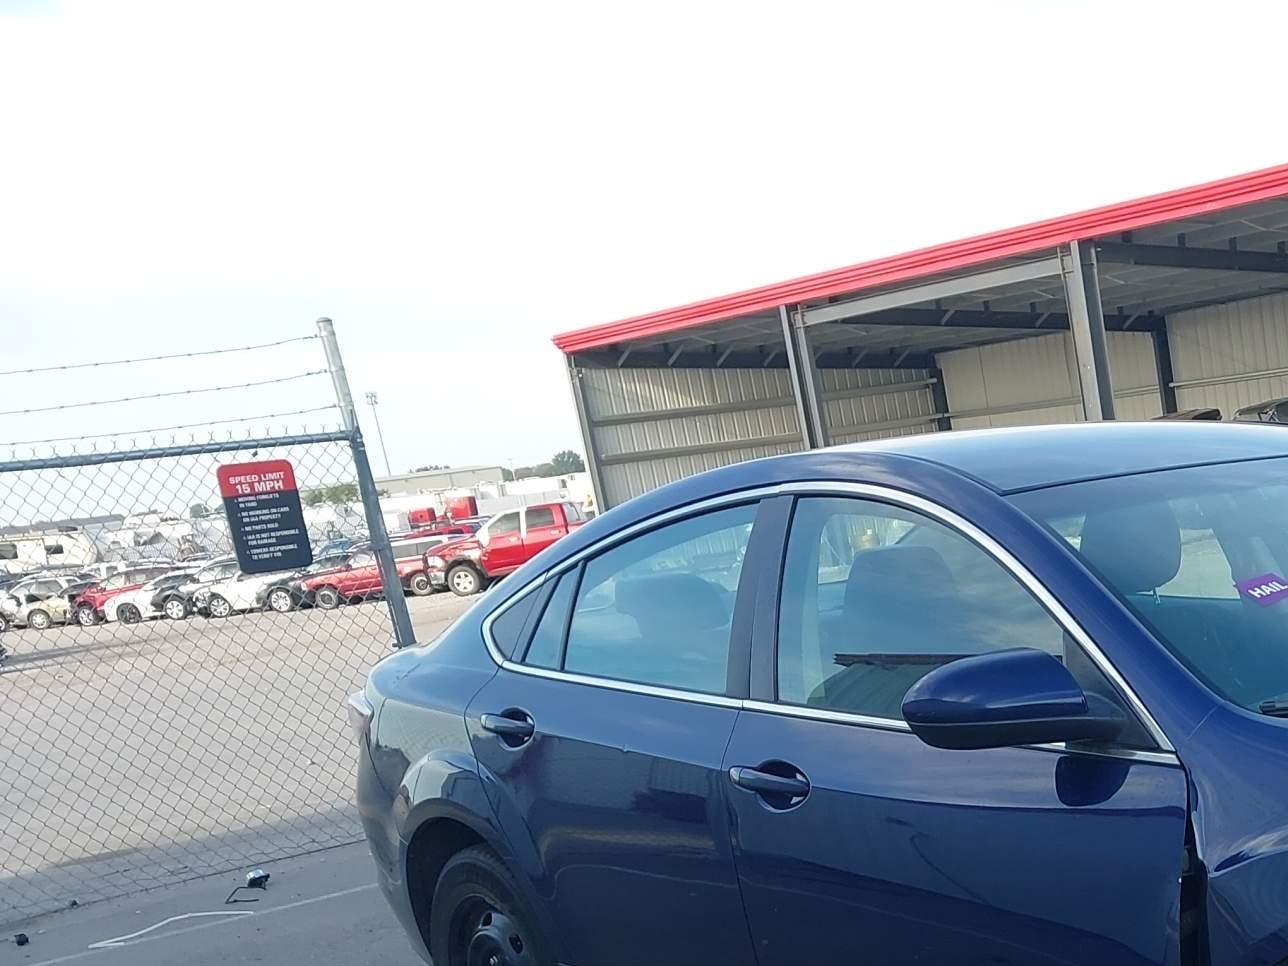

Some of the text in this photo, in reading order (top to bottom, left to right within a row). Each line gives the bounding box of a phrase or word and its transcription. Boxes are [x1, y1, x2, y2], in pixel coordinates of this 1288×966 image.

[229, 471, 285, 485] SPEED LIMIT
[236, 479, 284, 494] 15 MPH
[1247, 581, 1288, 598] HAIL
